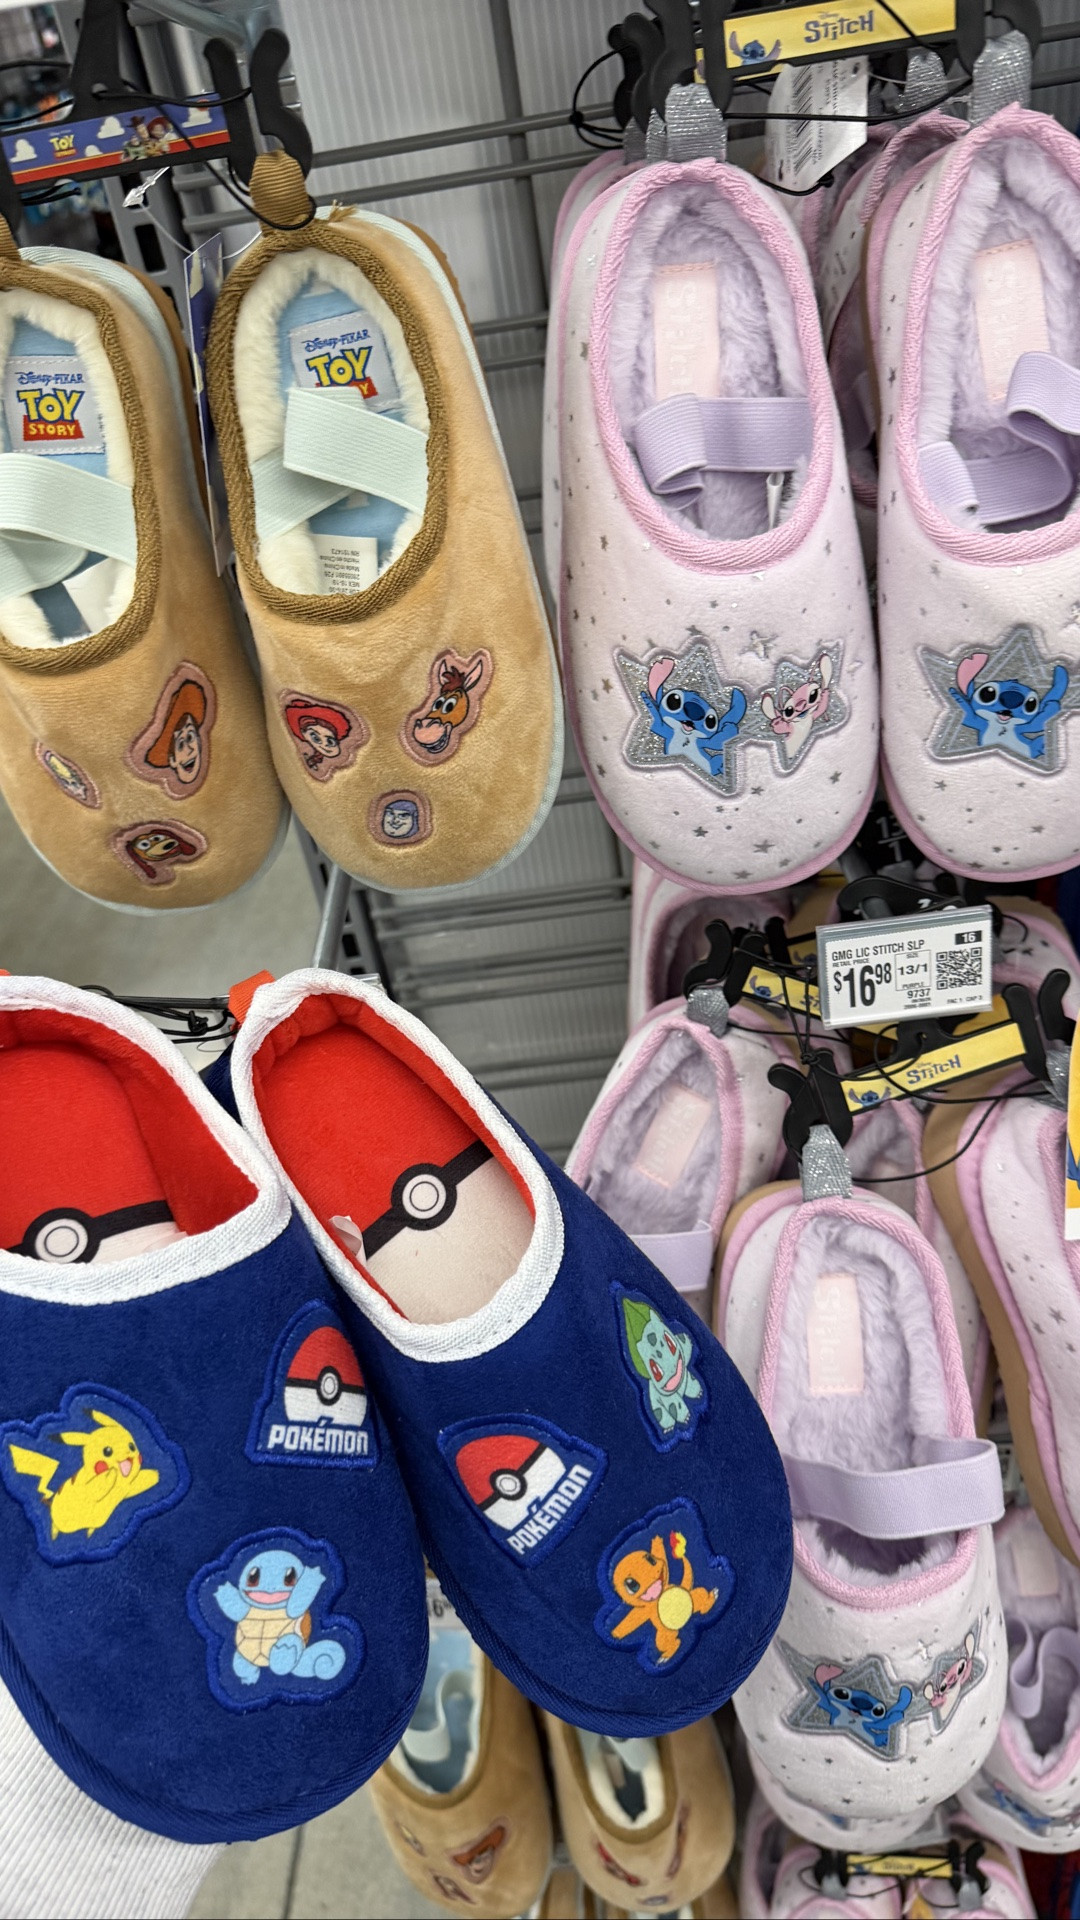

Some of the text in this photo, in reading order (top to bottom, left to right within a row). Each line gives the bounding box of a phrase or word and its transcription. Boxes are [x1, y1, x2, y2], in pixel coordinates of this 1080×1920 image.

[49, 134, 75, 151] TOY
[305, 345, 373, 388] TOY
[16, 387, 86, 424] TOY
[28, 423, 76, 436] STORY
[961, 931, 977, 943] 16
[832, 939, 925, 961] GMG LIC STITCH SLP
[853, 958, 870, 966] PRICE
[897, 963, 928, 975] 13/1
[902, 981, 925, 989] PURPLE
[907, 988, 931, 999] 9737
